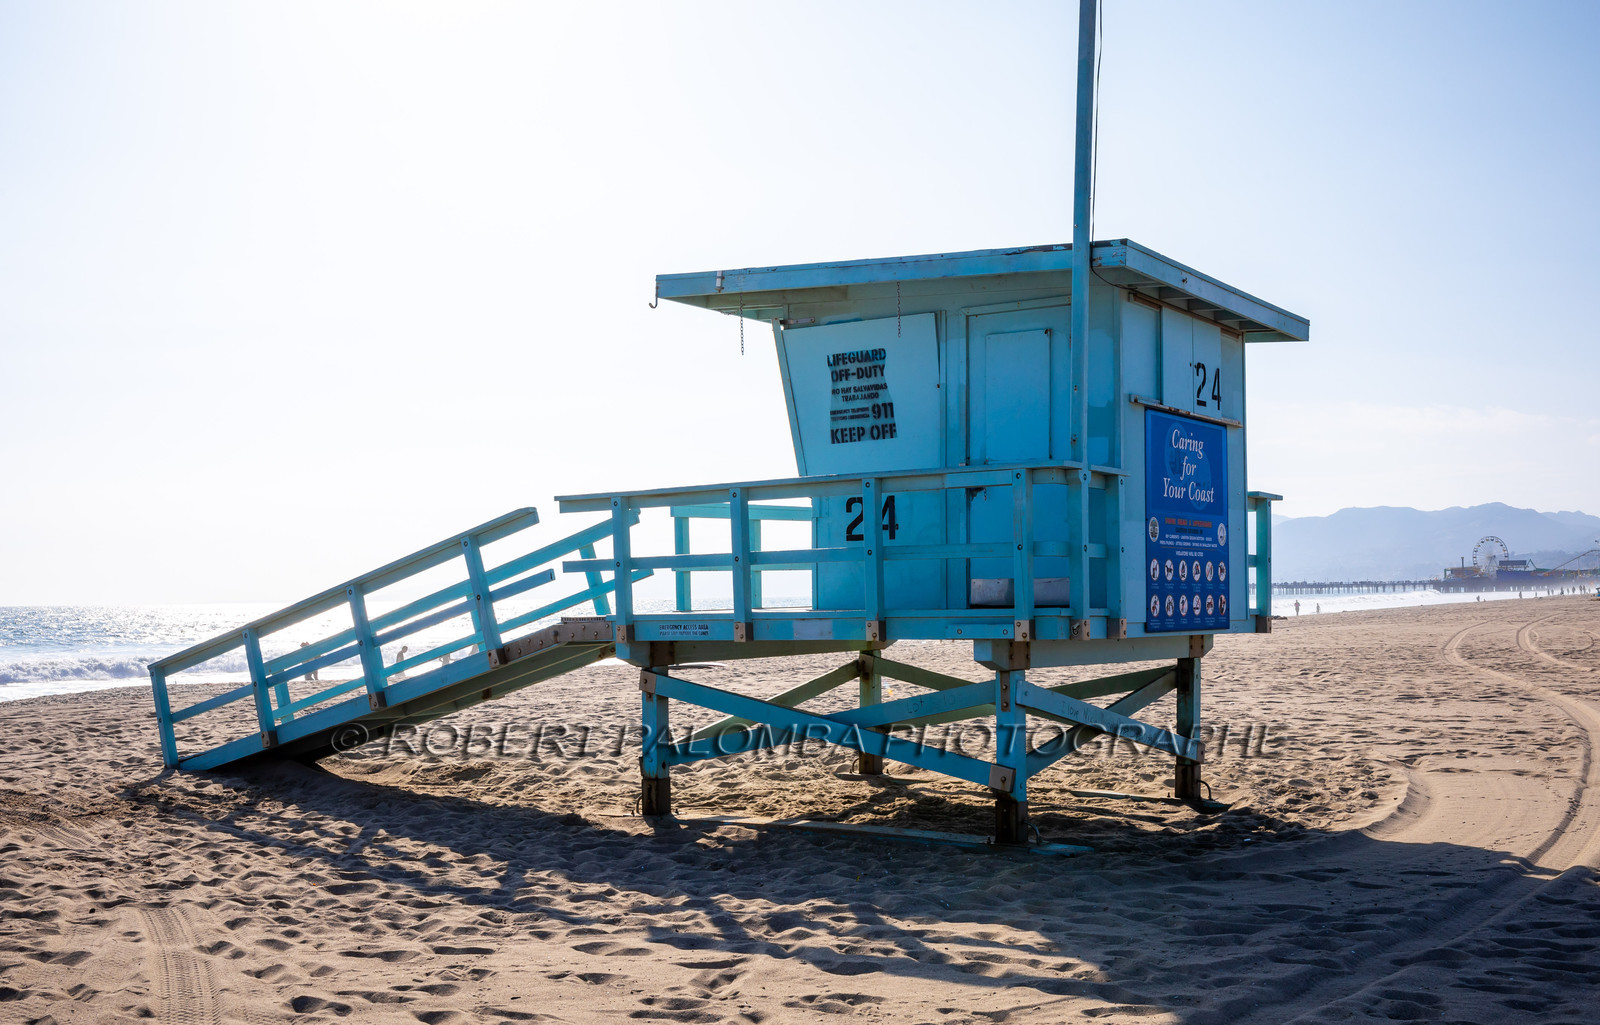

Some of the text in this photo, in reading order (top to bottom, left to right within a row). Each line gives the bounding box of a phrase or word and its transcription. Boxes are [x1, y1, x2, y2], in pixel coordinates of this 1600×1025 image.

[827, 348, 886, 367] LIFEGUARD
[831, 364, 885, 382] OFF-DUTY
[841, 387, 852, 395] HAY
[853, 382, 888, 393] SALVAVIDAS
[1196, 361, 1221, 411] 24
[842, 392, 879, 402] TRABAJANDO
[871, 402, 894, 419] 911
[831, 423, 896, 444] KEEP OFF
[1172, 429, 1204, 459] Caring
[1180, 456, 1196, 480] for
[1163, 477, 1214, 503] Your Coast
[846, 495, 899, 541] 24
